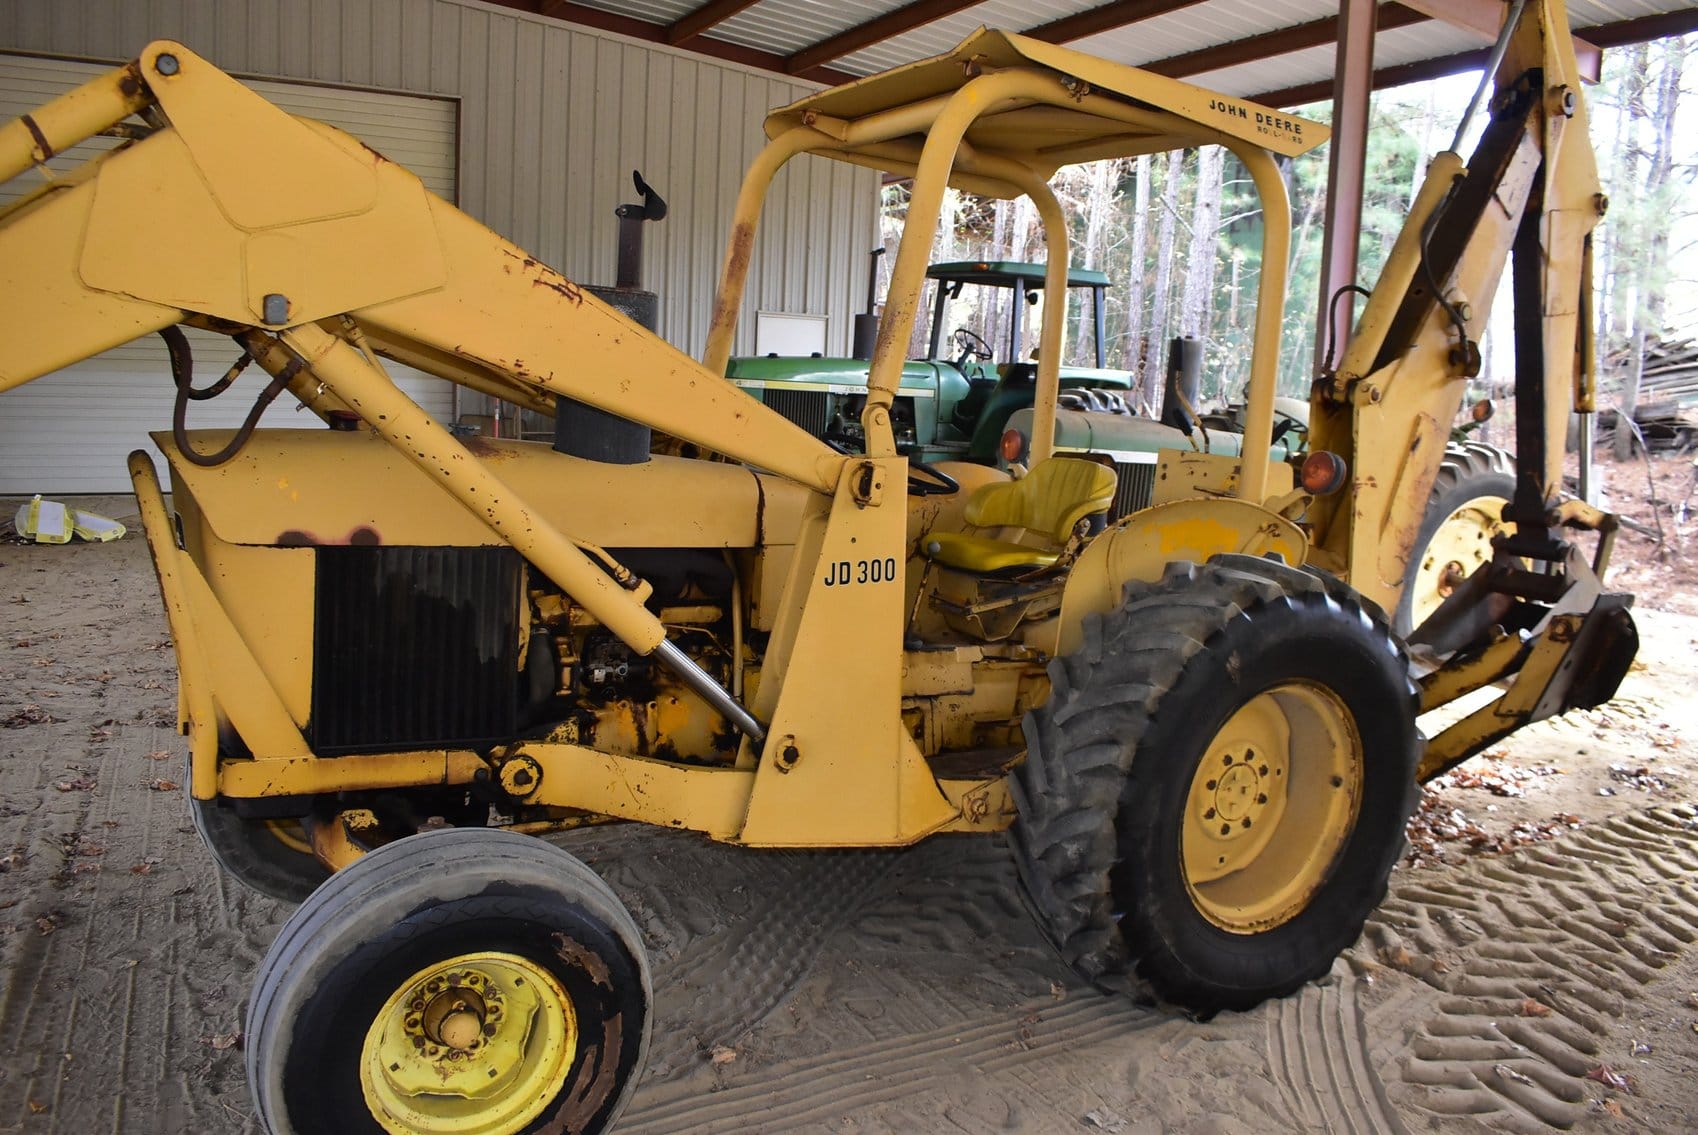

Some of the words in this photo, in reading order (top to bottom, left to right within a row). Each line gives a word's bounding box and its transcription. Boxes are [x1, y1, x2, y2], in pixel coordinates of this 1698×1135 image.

[1209, 99, 1248, 119] JOHN
[1255, 112, 1302, 135] DEERE
[824, 561, 851, 586] JD
[857, 557, 895, 584] 300
